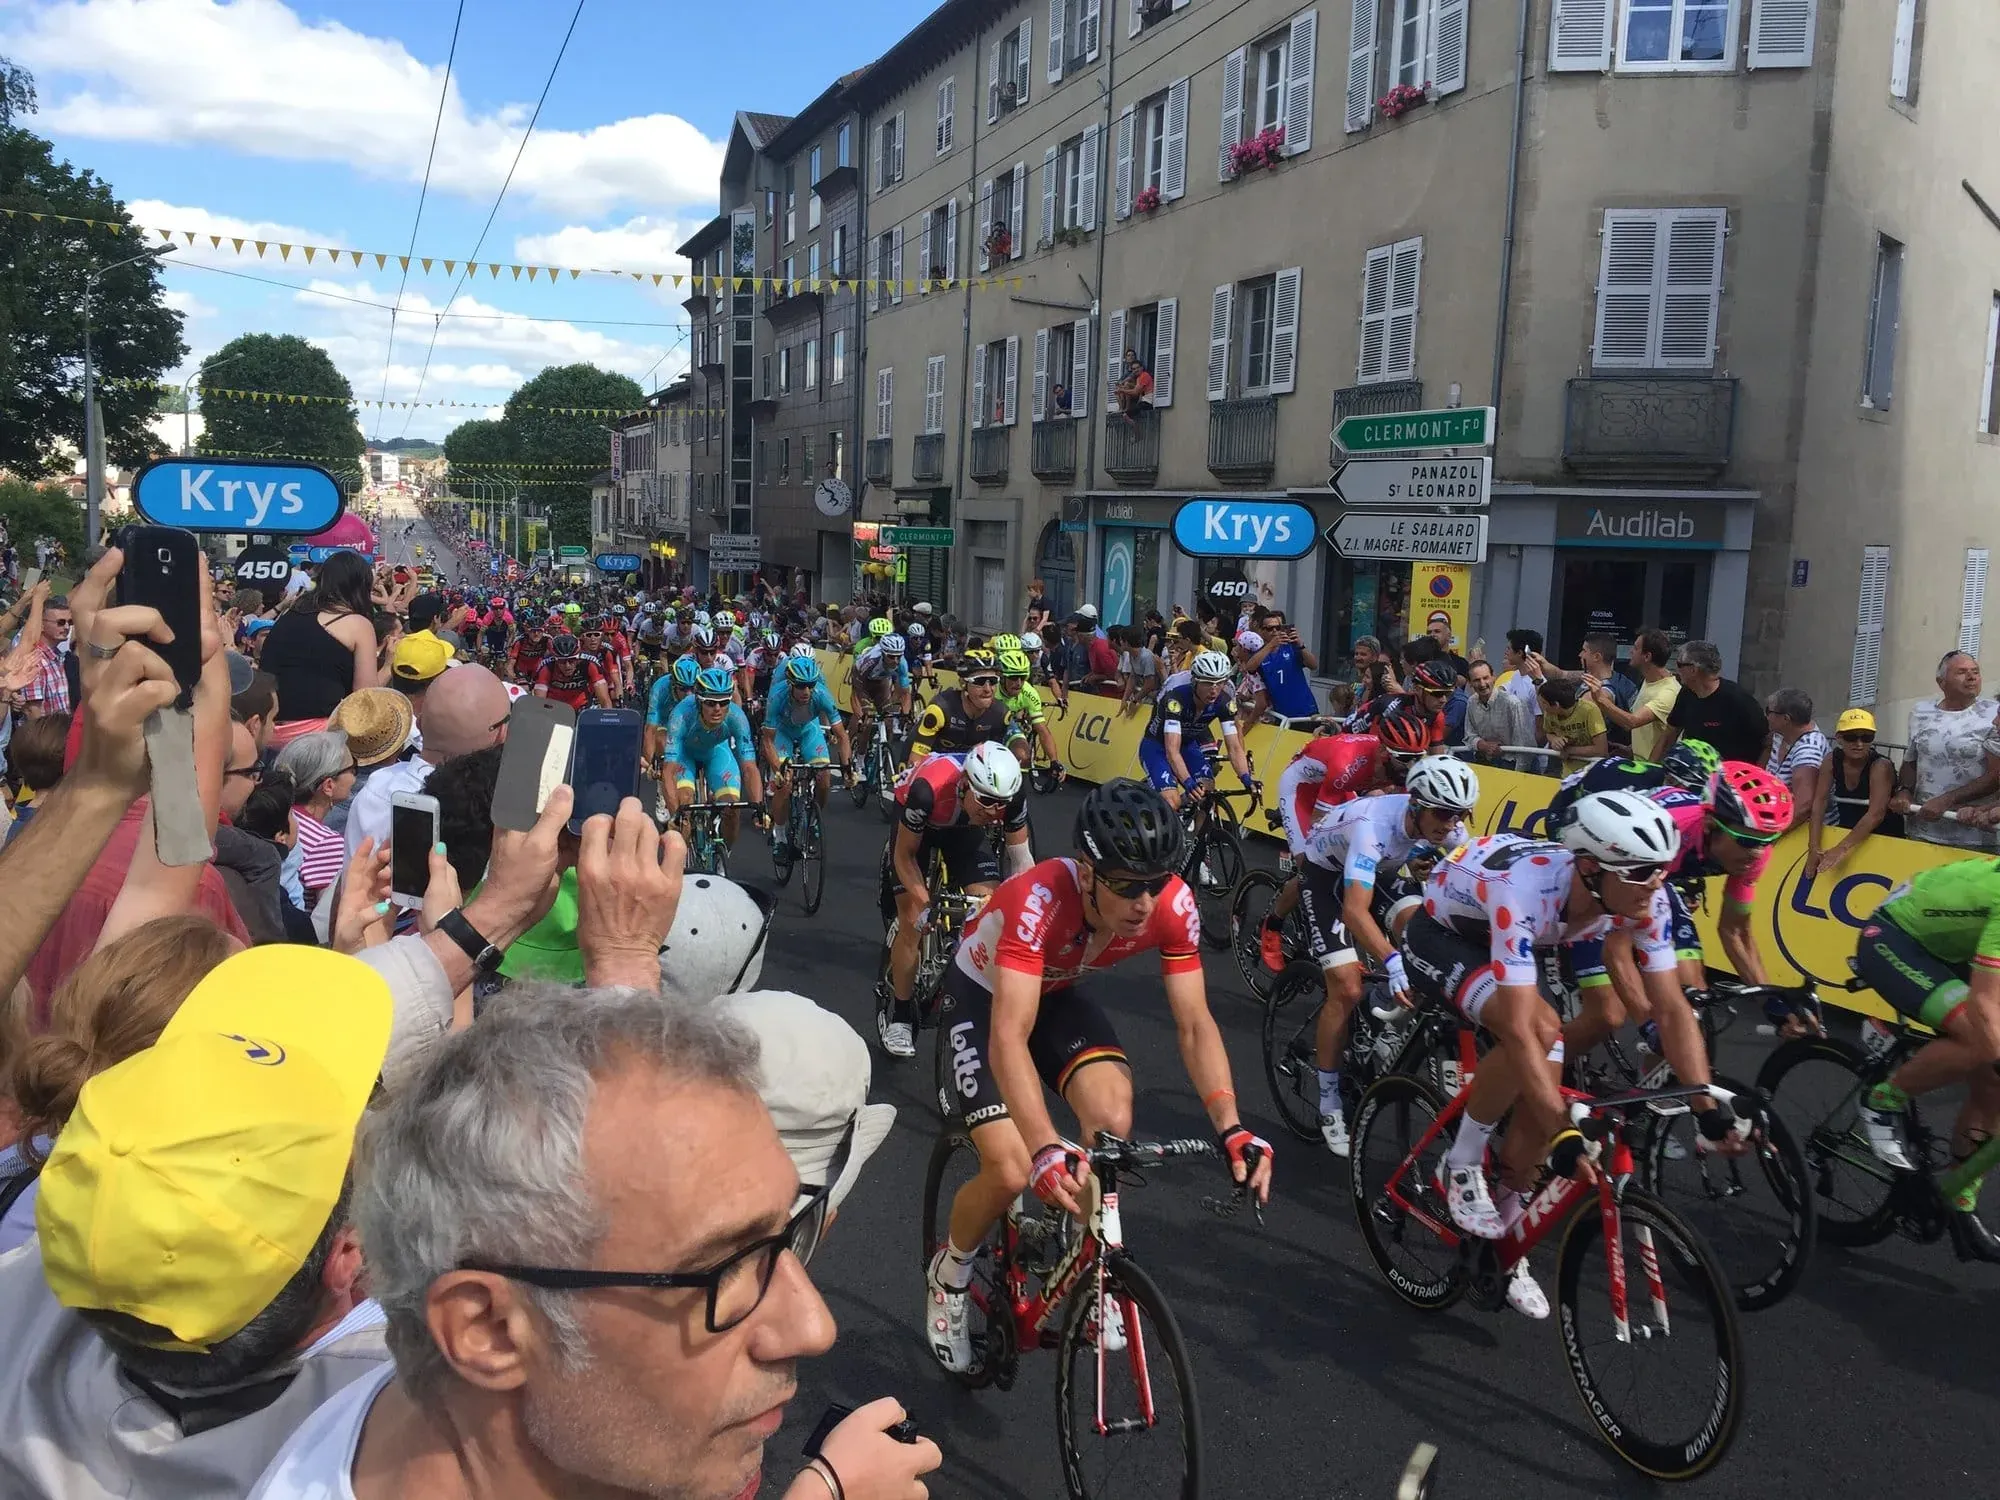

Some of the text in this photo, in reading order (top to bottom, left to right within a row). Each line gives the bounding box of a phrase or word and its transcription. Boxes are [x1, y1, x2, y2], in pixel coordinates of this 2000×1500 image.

[1411, 466, 1478, 479] PANAZOL
[180, 468, 304, 527] Krys
[1408, 484, 1477, 497] LEONARD
[1104, 502, 1133, 519] Audilab
[1586, 508, 1695, 539] Audilab
[1204, 504, 1291, 553] Krys
[1343, 538, 1360, 550] Z.I.
[1390, 522, 1475, 537] LE SABLARD
[237, 560, 288, 580] 450
[605, 555, 633, 568] Krys
[1421, 565, 1464, 573] ATTENTION
[1210, 581, 1248, 597] 450
[1075, 712, 1112, 746] LCL
[1333, 754, 1369, 790] Cofidis
[1496, 800, 1549, 840] LC
[1016, 881, 1053, 943] CAPS
[1791, 866, 1894, 929] LC
[950, 1021, 982, 1099] lotto
[965, 1102, 1008, 1127] SOUDA
[1511, 1175, 1576, 1243] TRE
[1561, 1302, 1622, 1439] BONTRAGER
